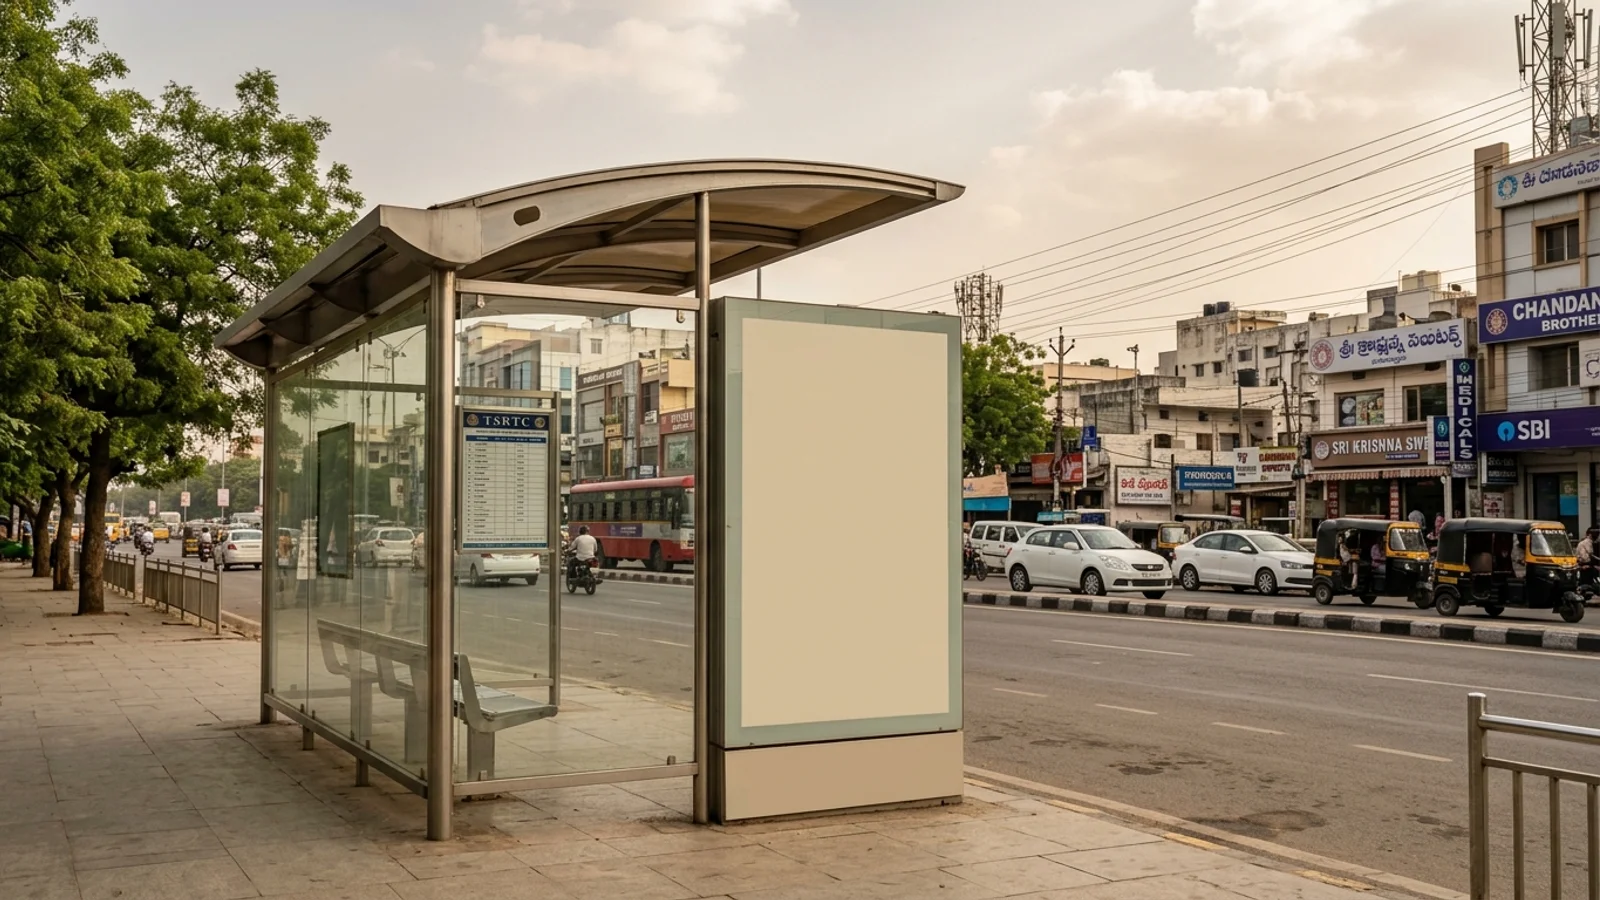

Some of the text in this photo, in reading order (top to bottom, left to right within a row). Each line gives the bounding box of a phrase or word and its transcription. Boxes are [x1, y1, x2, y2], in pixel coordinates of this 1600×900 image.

[1512, 291, 1600, 321] CHANDAN
[482, 416, 530, 427] TSRTC
[1517, 419, 1551, 441] SBI
[1332, 440, 1349, 455] SRI
